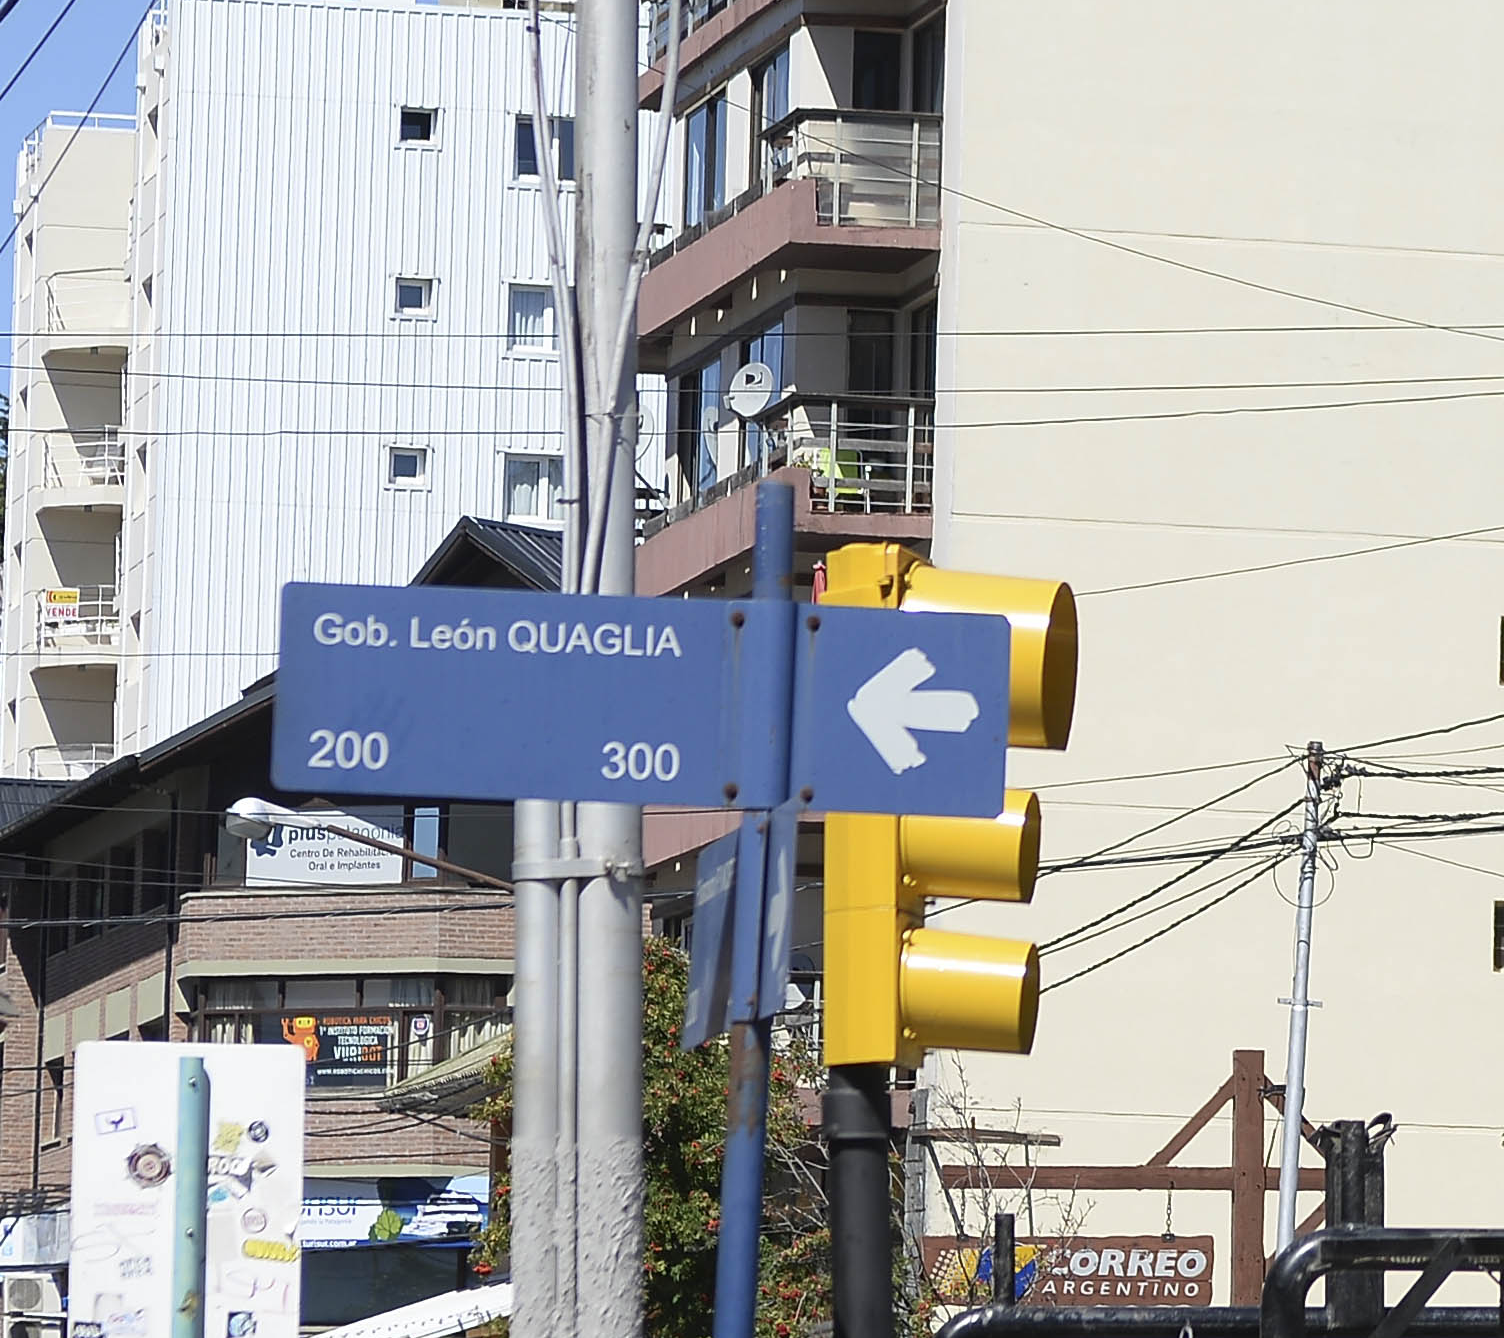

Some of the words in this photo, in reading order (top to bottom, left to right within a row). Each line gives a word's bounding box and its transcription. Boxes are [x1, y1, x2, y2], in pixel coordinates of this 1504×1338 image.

[313, 612, 397, 647] Gob.
[410, 616, 496, 651] León
[508, 619, 683, 659] QUAGLIA
[307, 728, 390, 771] 200
[601, 741, 681, 782] 300
[289, 848, 320, 859] Centro
[323, 848, 335, 858] De
[308, 861, 327, 871] Oral
[329, 862, 335, 870] e
[337, 860, 381, 871] Implantes
[1048, 1248, 1207, 1278] CORREO
[1042, 1280, 1200, 1298] ARGENTINO
